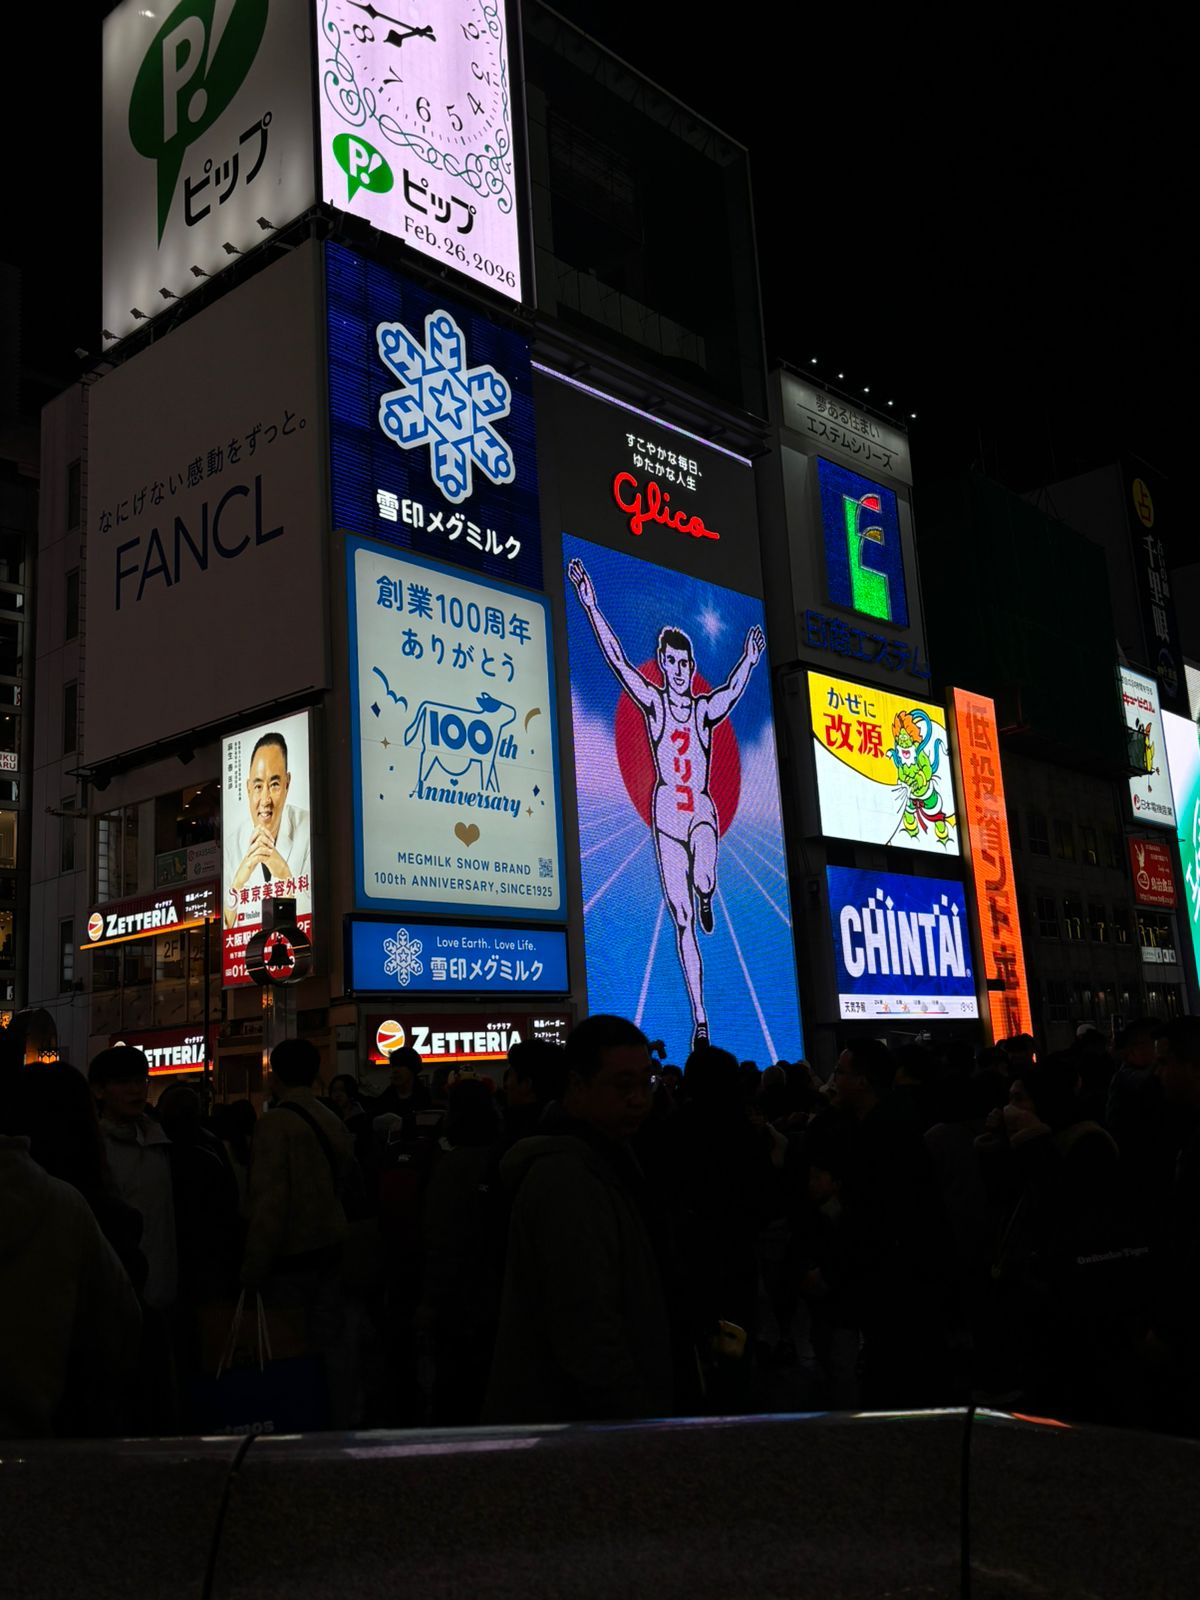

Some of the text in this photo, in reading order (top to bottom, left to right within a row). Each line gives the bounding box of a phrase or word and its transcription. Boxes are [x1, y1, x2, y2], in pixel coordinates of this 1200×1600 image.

[353, 24, 375, 43] 8
[461, 23, 480, 41] 2
[383, 66, 403, 85] 7
[471, 62, 490, 86] 3
[416, 97, 431, 123] 6
[447, 104, 463, 131] 5
[467, 92, 485, 115] 4
[184, 111, 273, 227] ピップ
[403, 168, 477, 234] ピップ
[625, 433, 702, 477] すこやかな毎日、
[99, 410, 306, 533] なにげない感動をずっと。
[633, 453, 697, 491] ゆたかな人生
[614, 471, 720, 540] Glico
[376, 489, 521, 560] 雪印メグミルク
[116, 474, 284, 610] FANCL
[376, 575, 532, 645] 創業100周年
[401, 628, 515, 683] ありがとう
[827, 687, 876, 719] かぜに
[823, 713, 884, 758] 改源
[670, 727, 695, 812] グリコ
[409, 778, 521, 817] Anniversary
[374, 872, 406, 886] 100th
[397, 852, 532, 875] MEGMILK SNOW BRAND
[240, 874, 309, 905] 東京美容外科
[105, 905, 179, 938] ZETTERIA
[437, 936, 537, 951] Love Earth. Love Life.
[430, 954, 544, 982] 雪印メグミルク
[132, 1043, 206, 1069] ETTERIA
[411, 1026, 522, 1055] ZETTERIA
